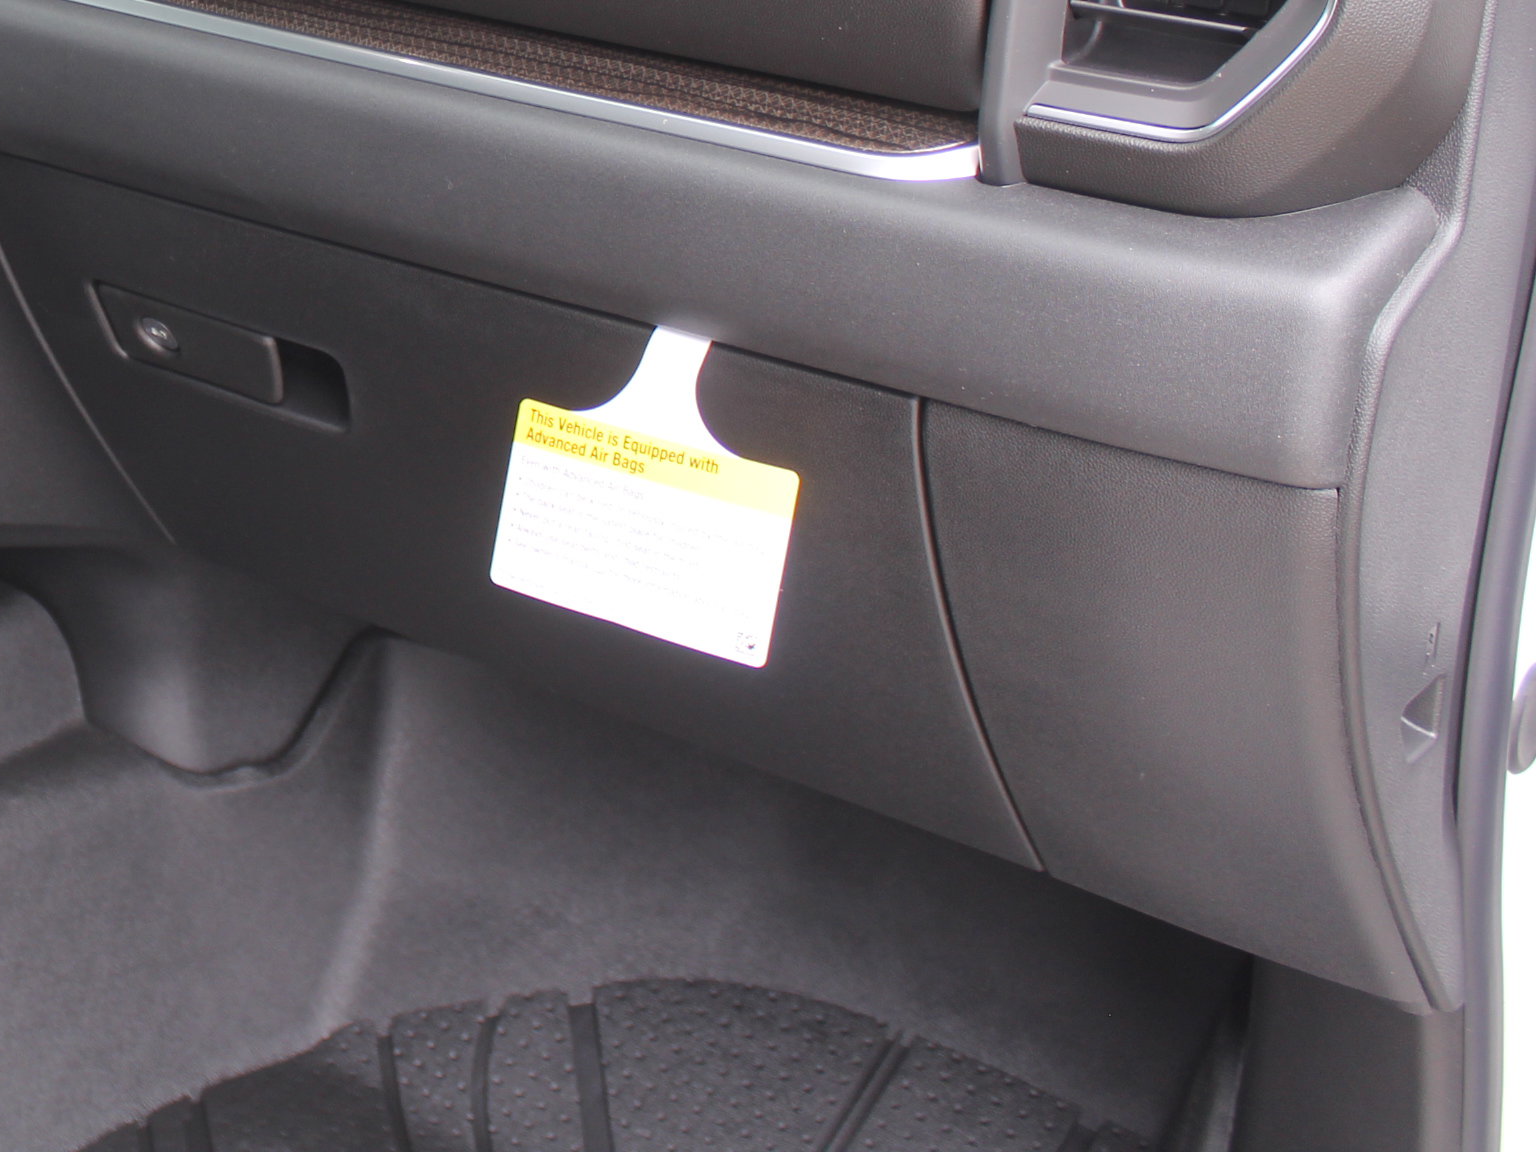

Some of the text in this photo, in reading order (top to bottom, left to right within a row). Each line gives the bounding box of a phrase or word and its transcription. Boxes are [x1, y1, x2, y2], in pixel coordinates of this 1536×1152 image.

[526, 427, 645, 475] Advanced Air Bags
[530, 408, 719, 474] This Vehicle is Equipped with
